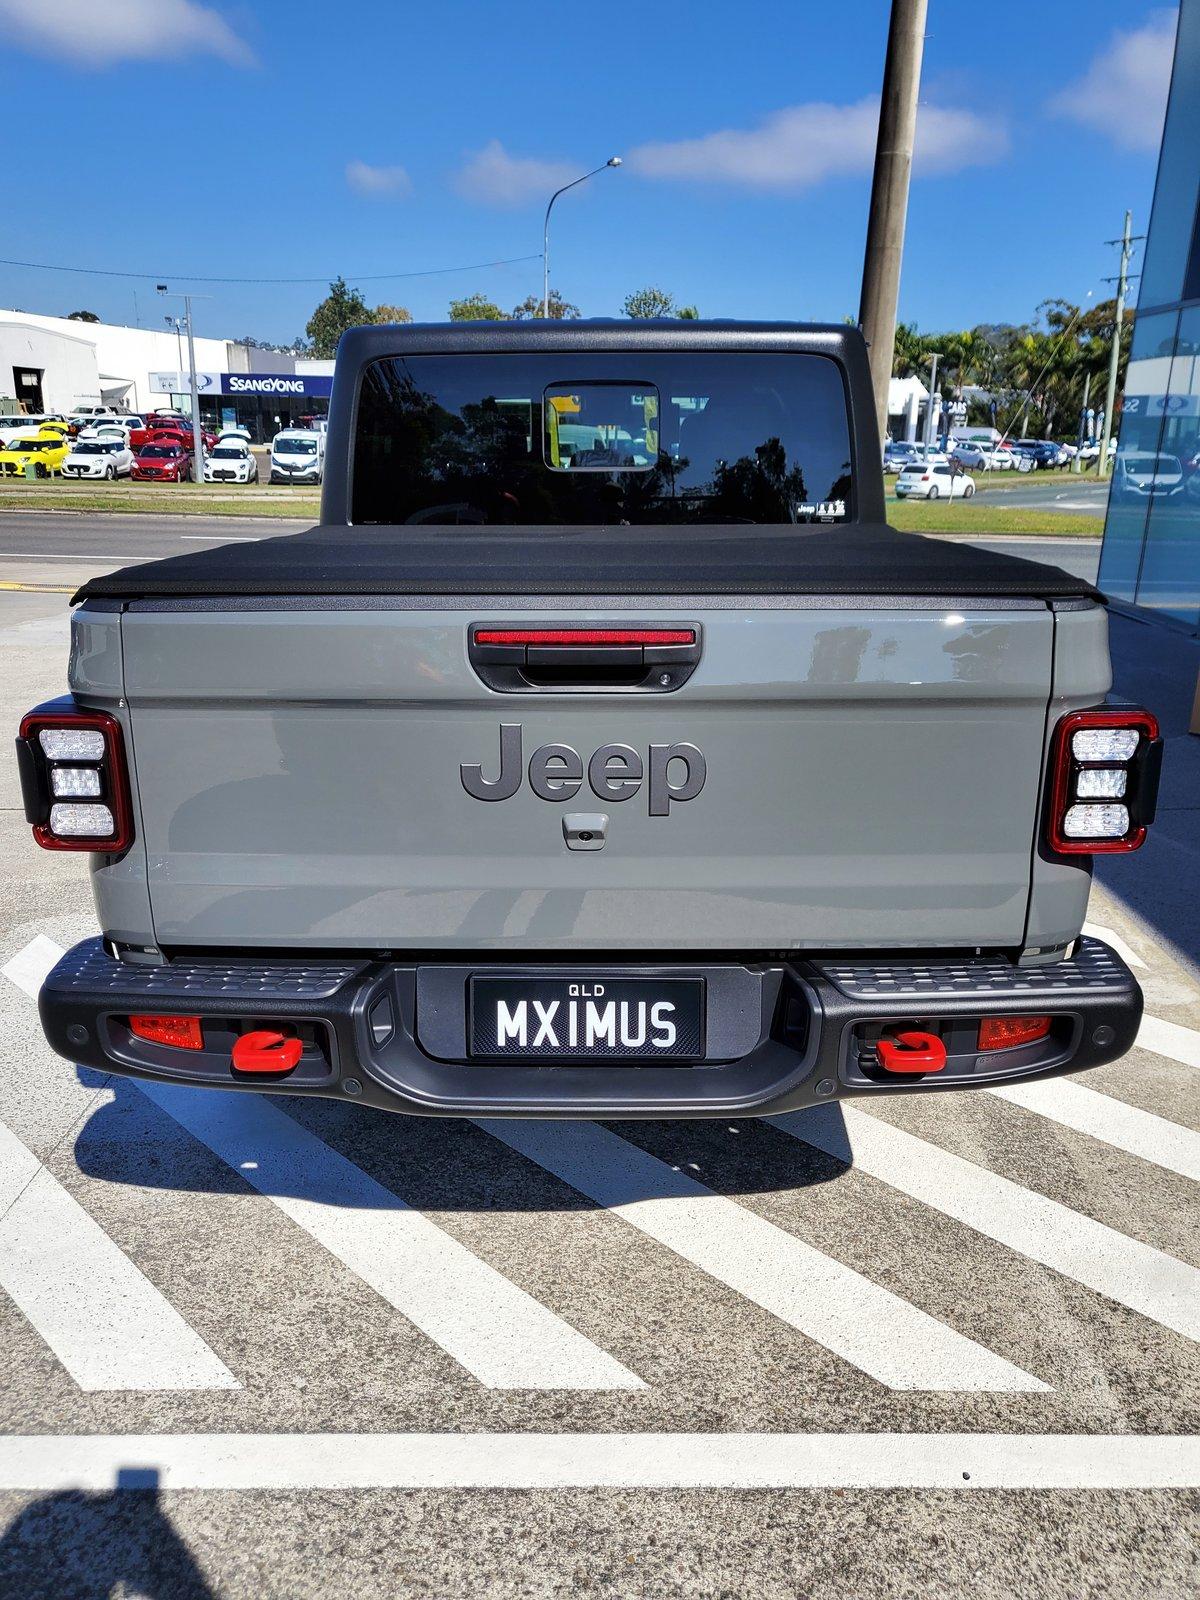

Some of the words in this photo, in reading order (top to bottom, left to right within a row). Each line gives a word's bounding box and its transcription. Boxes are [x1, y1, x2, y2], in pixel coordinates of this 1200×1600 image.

[230, 377, 304, 392] SSANGYONG
[798, 505, 815, 514] Jeep
[460, 723, 707, 817] Jeep
[569, 985, 605, 997] QLD
[497, 1000, 677, 1048] MXIMUS
